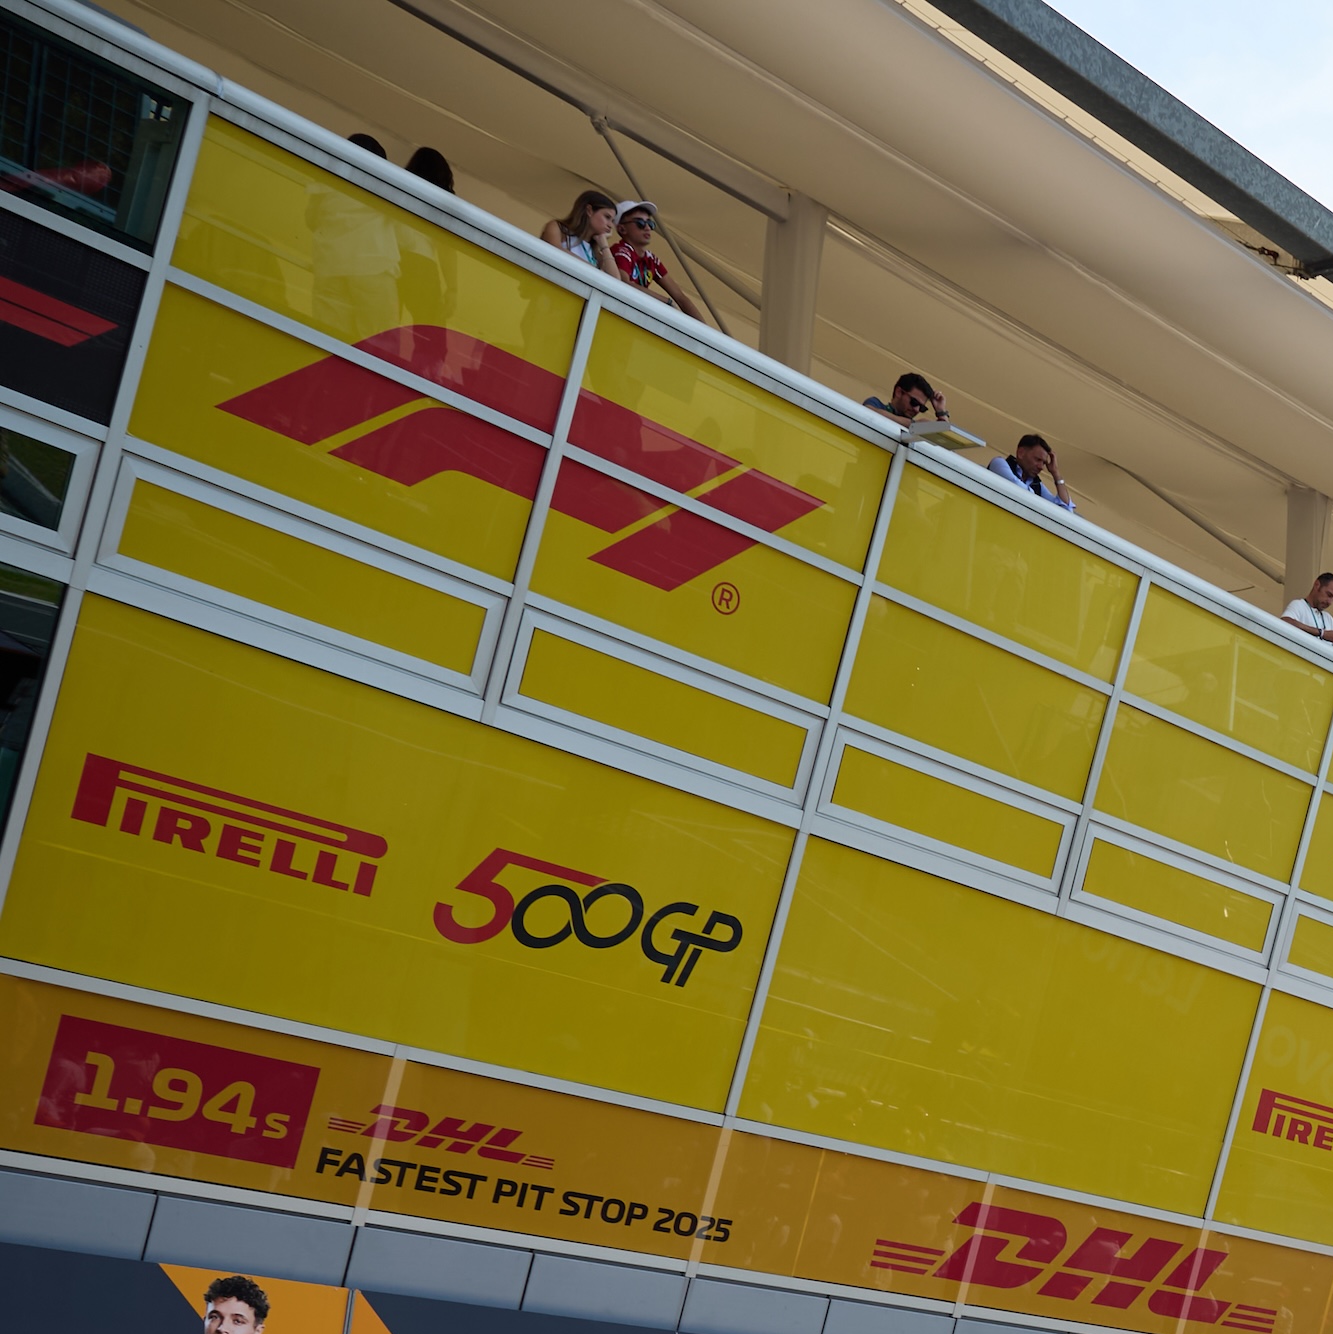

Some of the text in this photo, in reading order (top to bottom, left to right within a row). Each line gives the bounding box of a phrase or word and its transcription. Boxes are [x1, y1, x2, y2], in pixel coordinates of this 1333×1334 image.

[70, 752, 389, 897] PIRELLI
[73, 1051, 289, 1141] 1.94s
[361, 1103, 526, 1165] DHL
[314, 1147, 733, 1243] FASTEST PIT STOP 2025
[934, 1201, 1234, 1326] DHL
